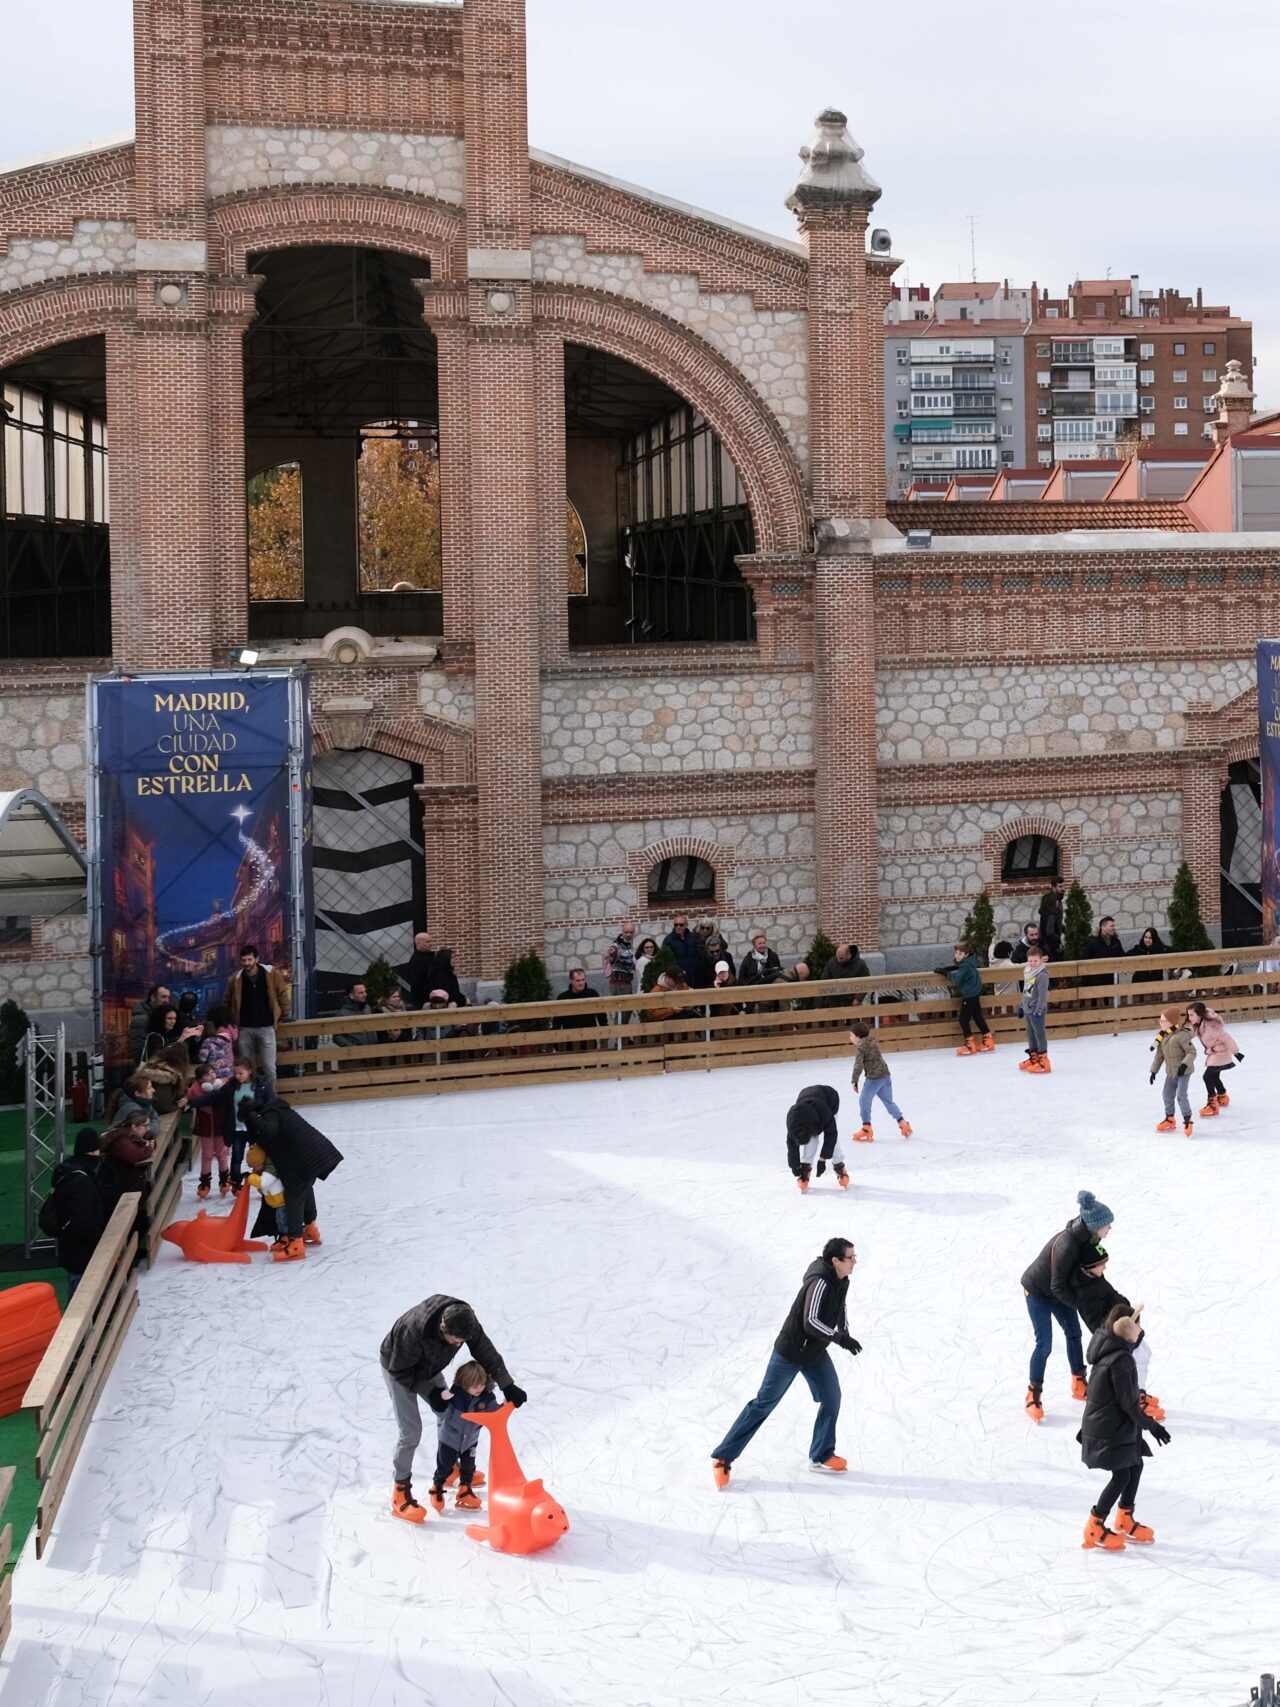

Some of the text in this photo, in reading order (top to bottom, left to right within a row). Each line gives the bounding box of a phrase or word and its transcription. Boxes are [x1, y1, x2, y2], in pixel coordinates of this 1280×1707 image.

[154, 692, 250, 713] MADRID,
[173, 713, 221, 732] UNA
[157, 732, 237, 753] CIUDAD
[168, 753, 219, 773] CON
[137, 773, 252, 796] ESTRELLA
